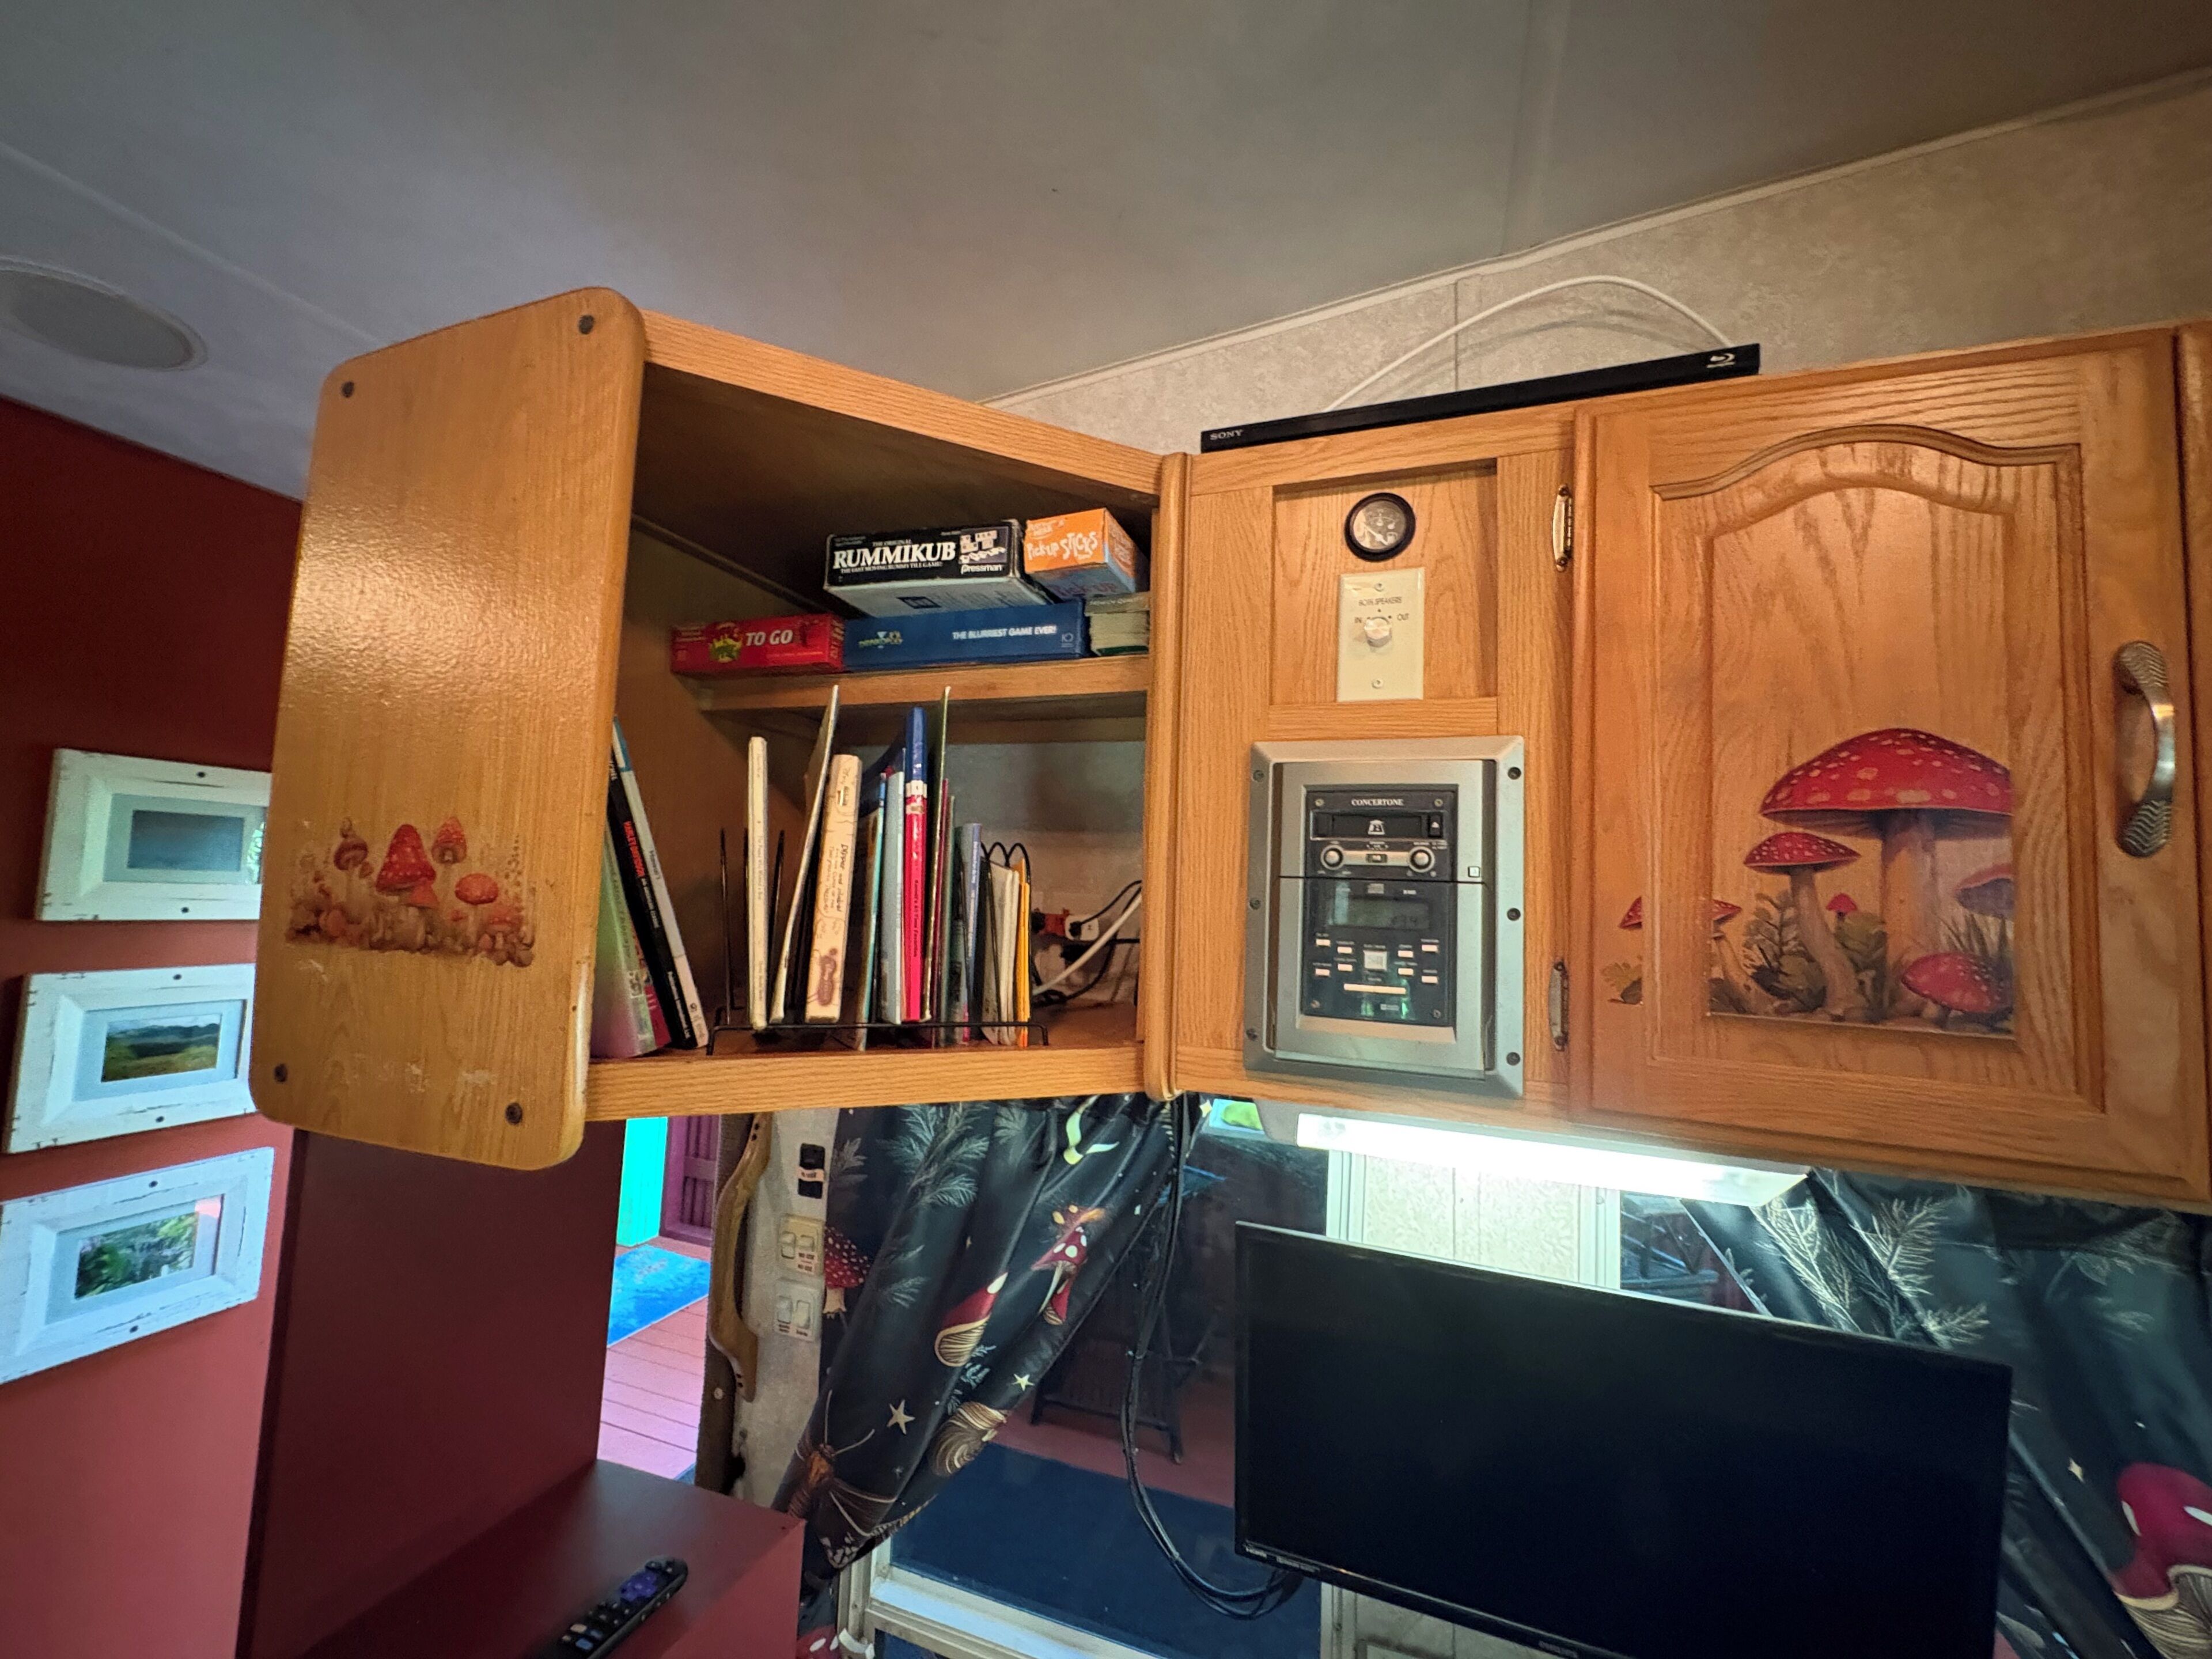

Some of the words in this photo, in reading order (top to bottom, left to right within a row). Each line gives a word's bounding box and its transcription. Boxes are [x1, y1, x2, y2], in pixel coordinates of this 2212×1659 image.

[1210, 429, 1244, 440] SONY
[833, 541, 956, 569] RUMMIKUB
[746, 631, 766, 646] TO
[770, 630, 793, 645] GO
[953, 631, 967, 639] THE
[1009, 627, 1032, 636] GAME
